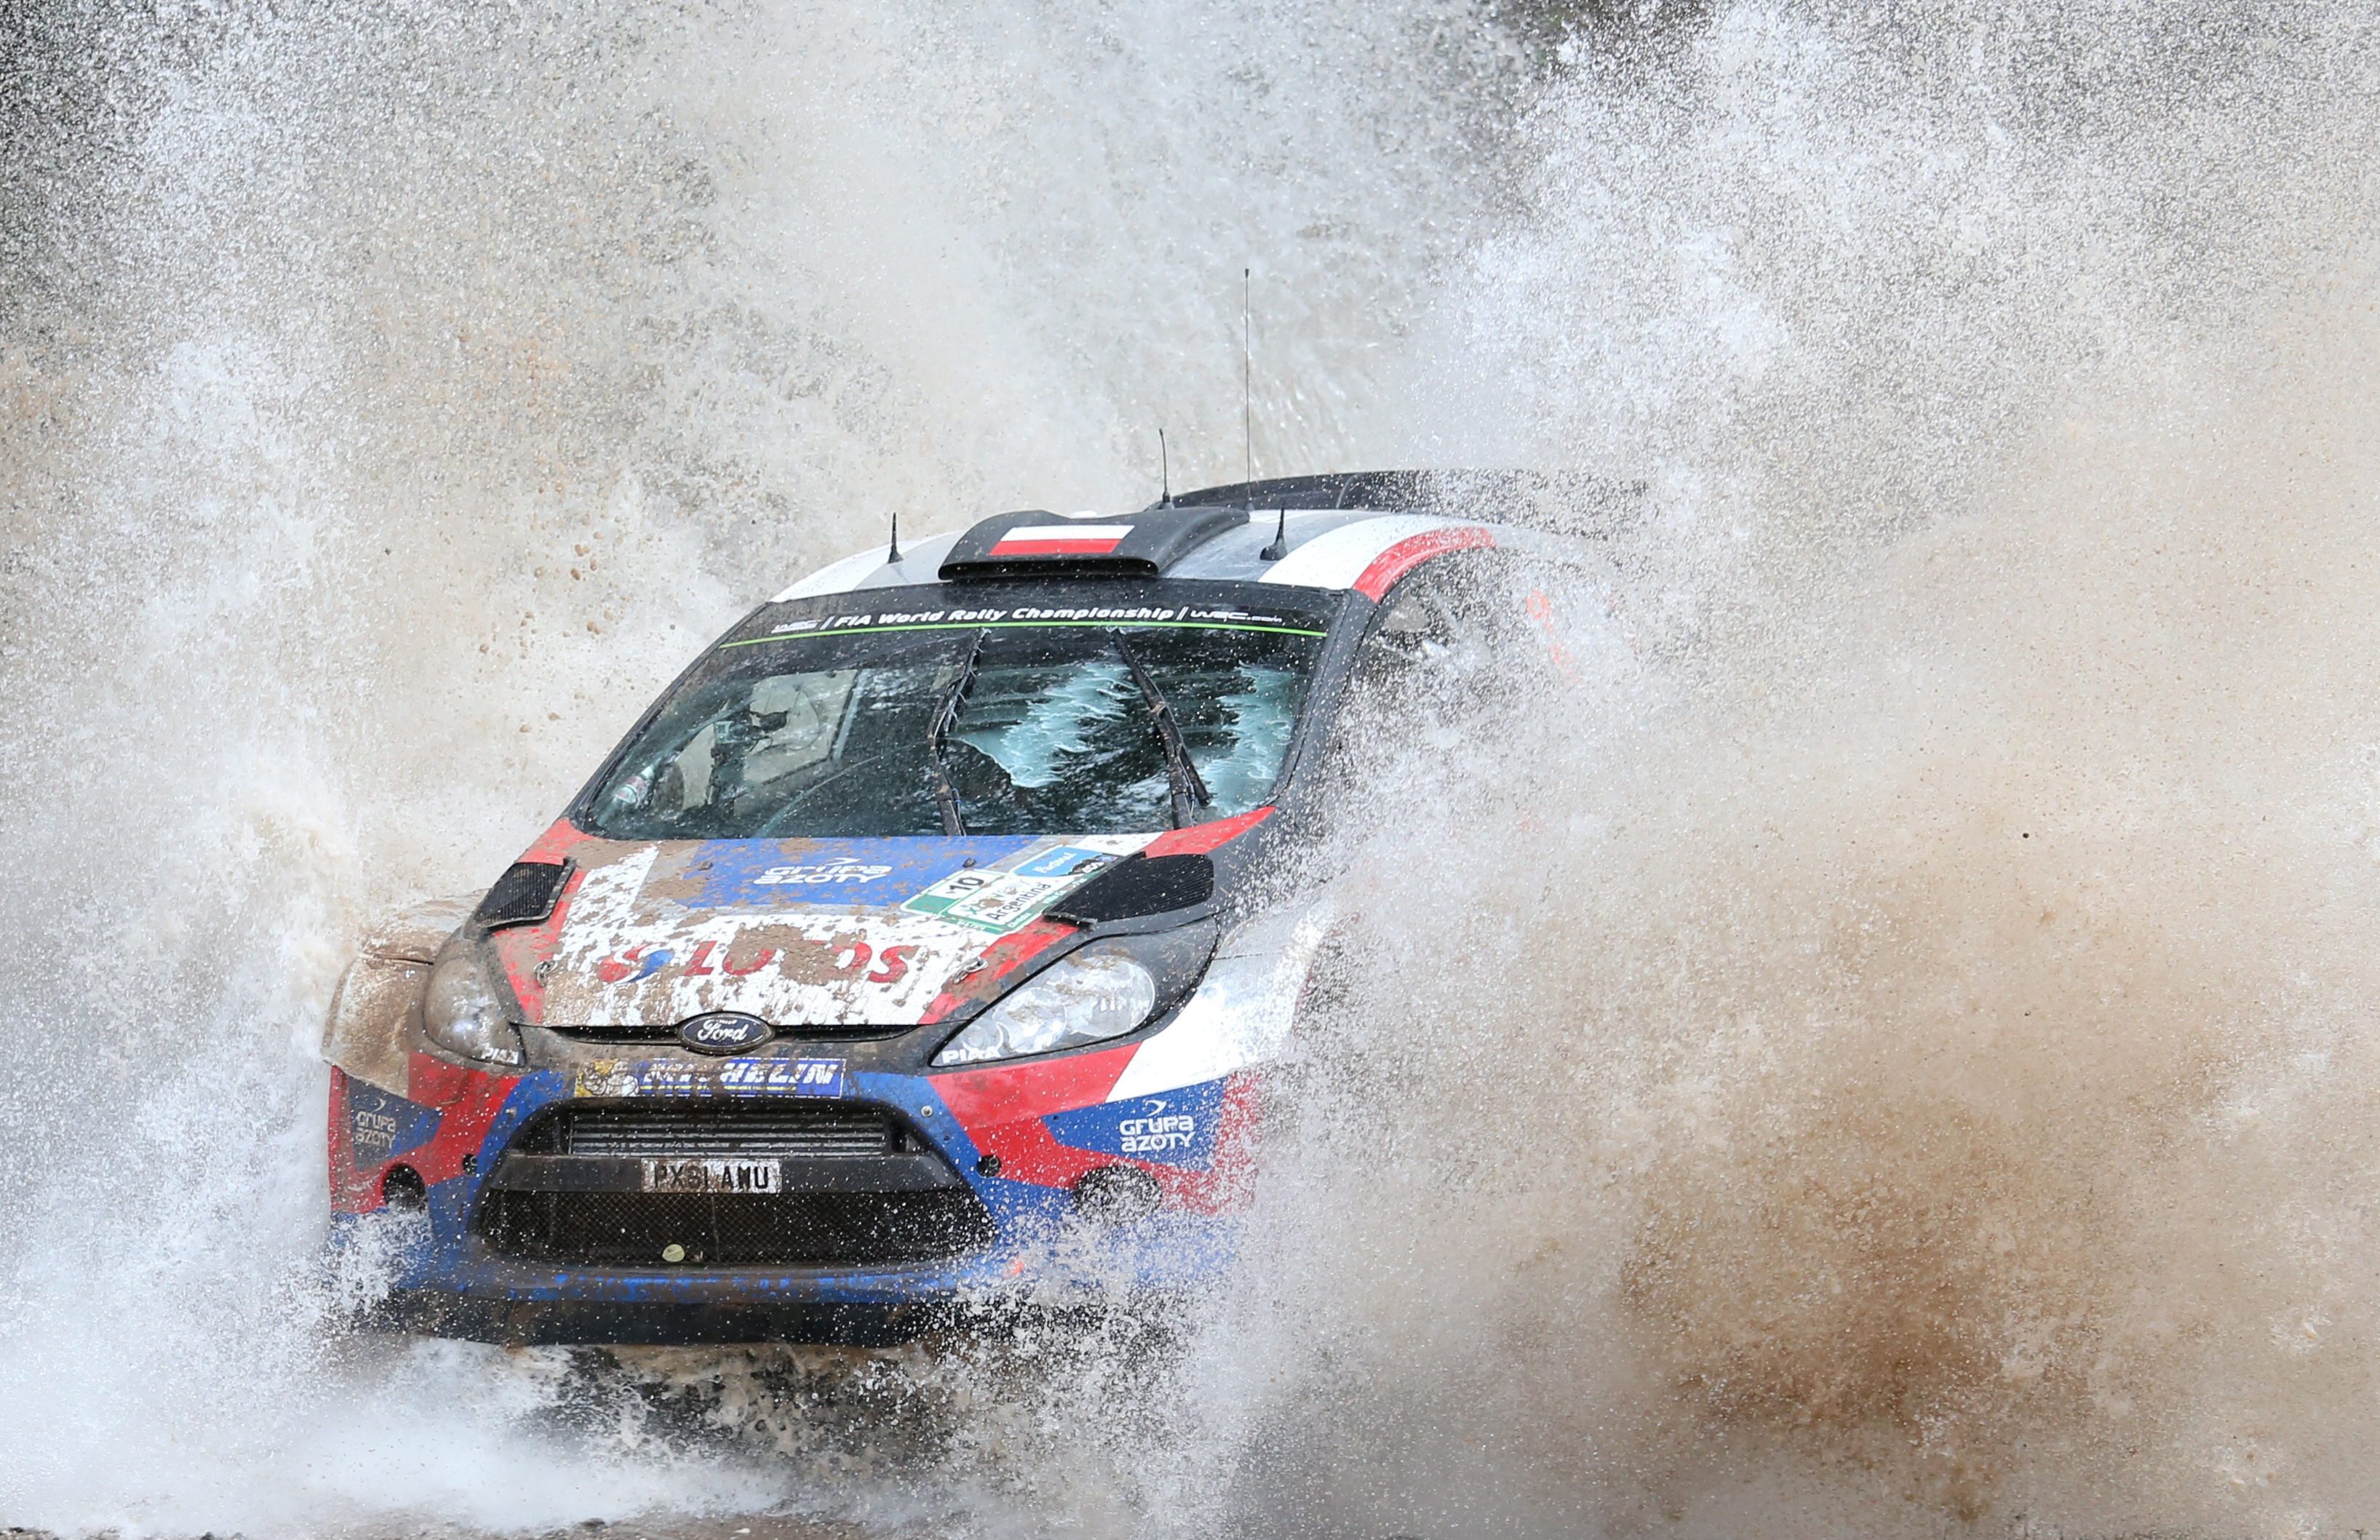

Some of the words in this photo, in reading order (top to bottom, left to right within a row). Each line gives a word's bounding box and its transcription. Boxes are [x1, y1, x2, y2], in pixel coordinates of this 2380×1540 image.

[834, 615, 872, 628] FIA
[877, 611, 945, 624] World
[947, 608, 1008, 621] Rally
[1012, 607, 1174, 621] Championship
[948, 876, 985, 892] 10
[985, 882, 1052, 921] Argentina
[697, 1019, 749, 1042] Ford
[942, 1046, 1001, 1064] PIAA
[721, 1165, 769, 1189] AMU
